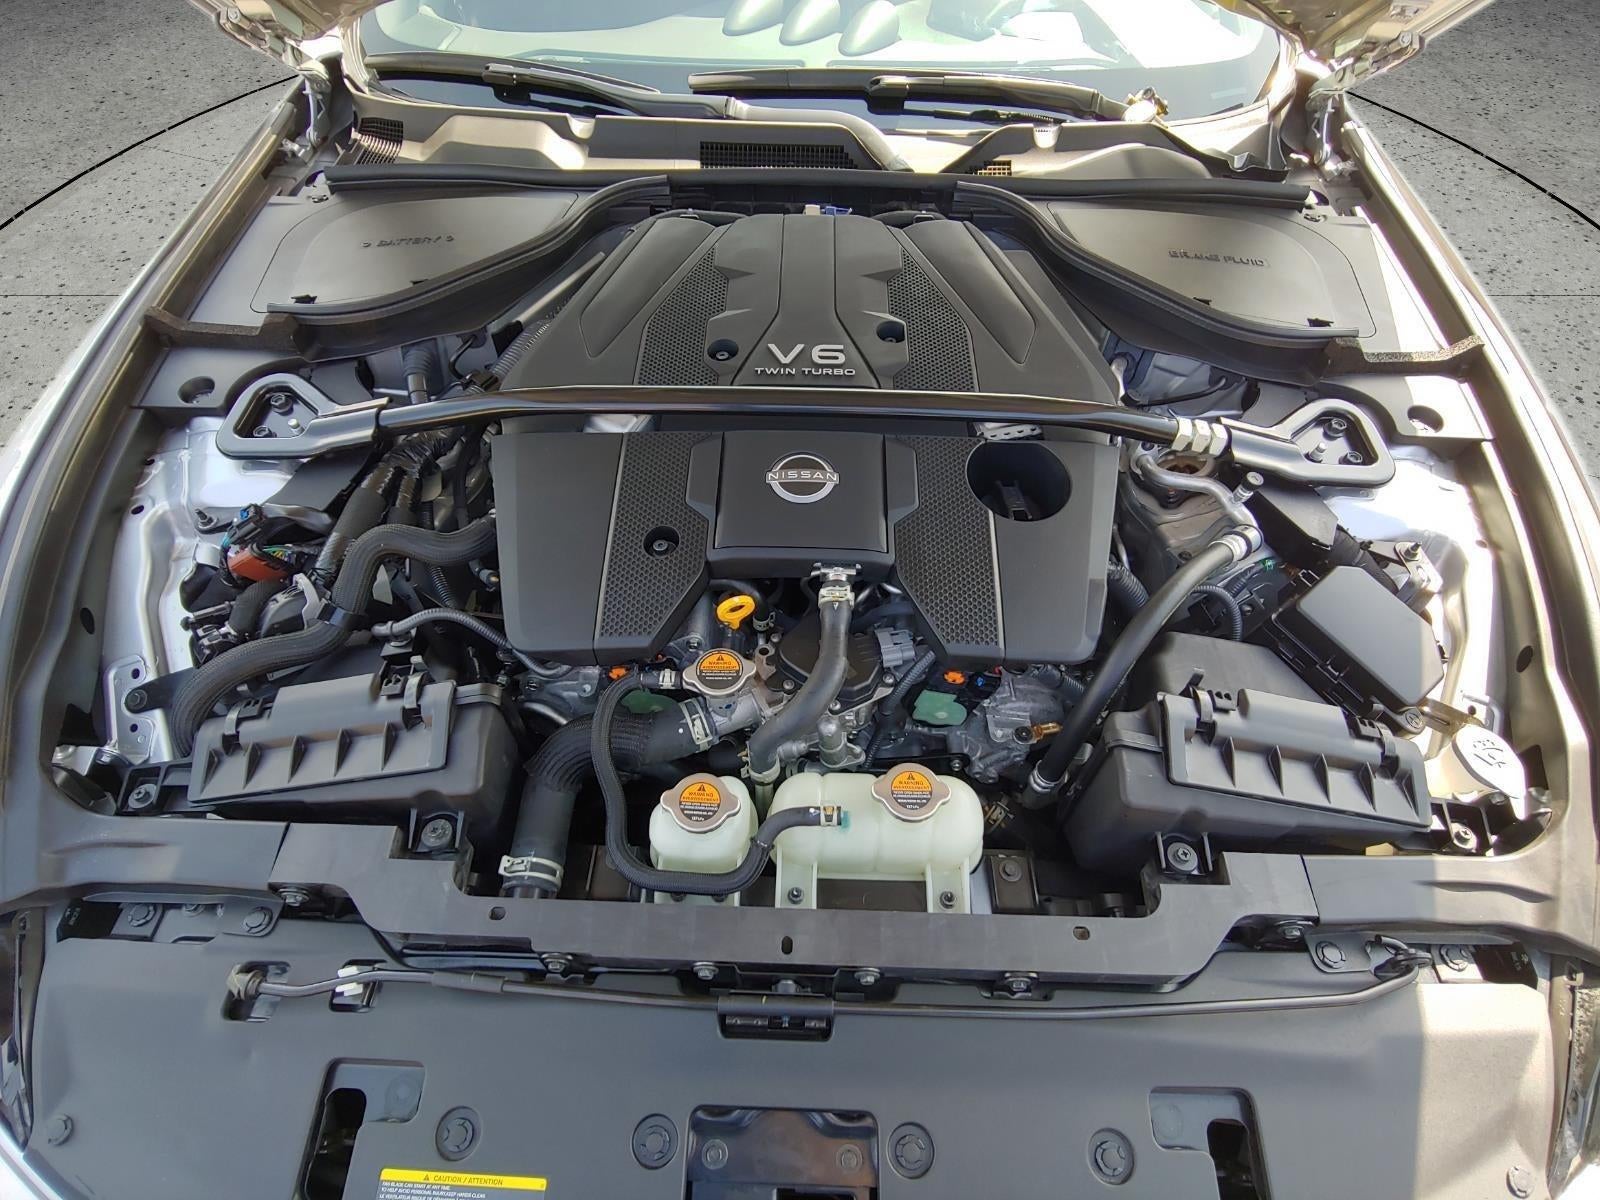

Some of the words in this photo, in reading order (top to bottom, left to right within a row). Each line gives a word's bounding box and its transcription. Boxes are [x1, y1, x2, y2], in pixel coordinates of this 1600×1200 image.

[377, 235, 441, 247] BATTERY
[1168, 250, 1220, 262] BRAKE
[1223, 255, 1265, 267] FLUID
[767, 343, 846, 364] V6
[755, 367, 796, 375] TWIN
[801, 367, 856, 376] TURBO
[768, 470, 837, 481] NISSAN
[468, 1177, 503, 1186] ATTENTION
